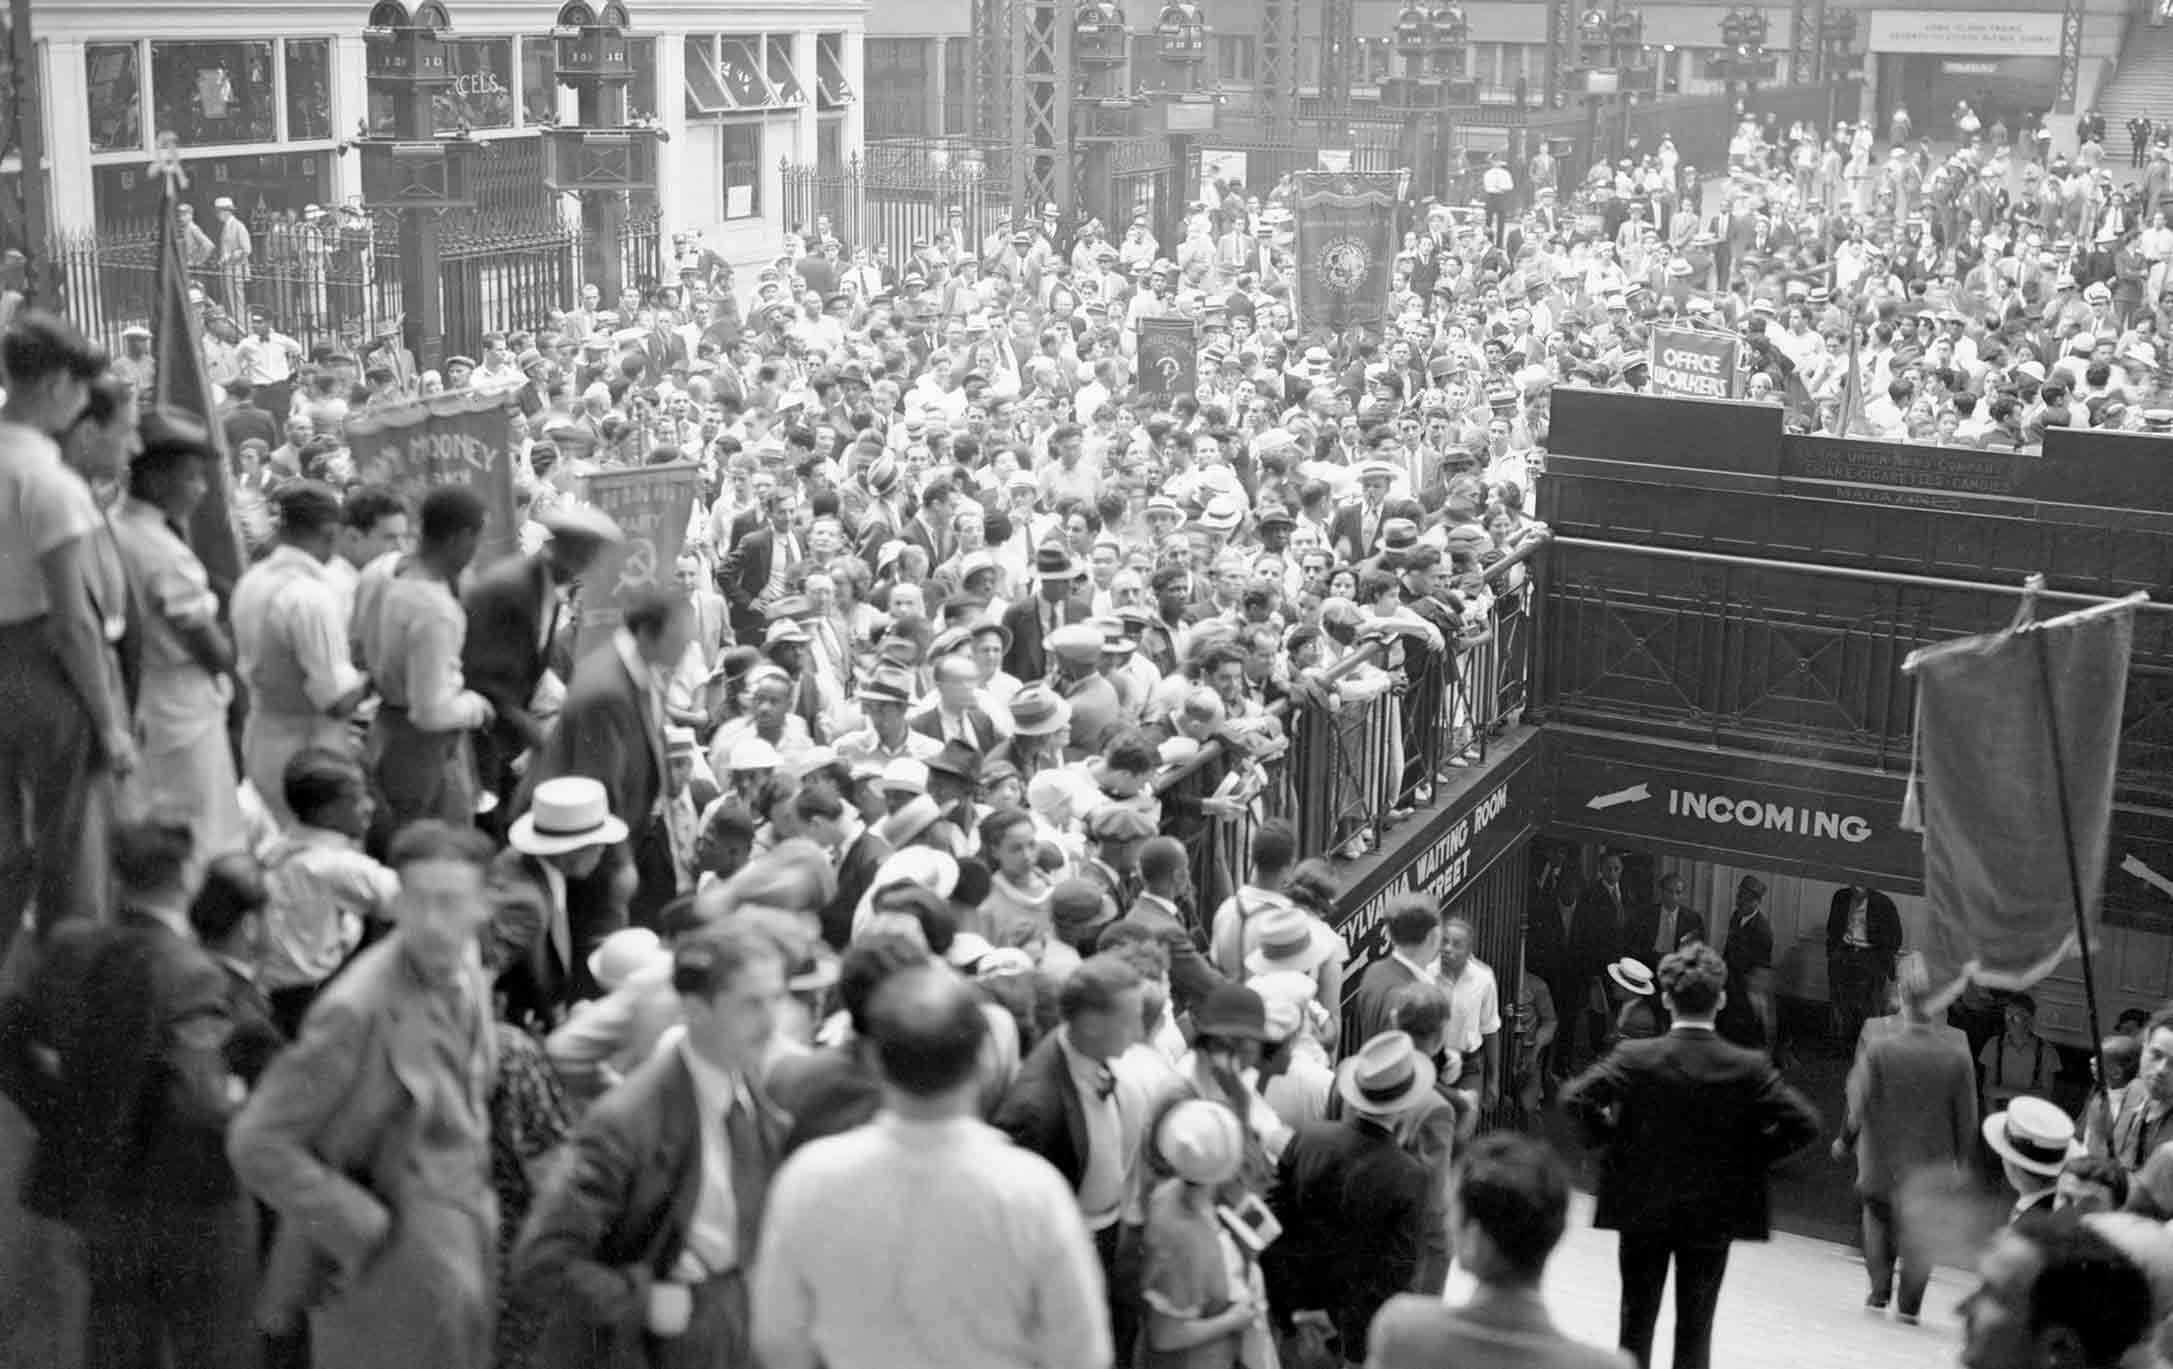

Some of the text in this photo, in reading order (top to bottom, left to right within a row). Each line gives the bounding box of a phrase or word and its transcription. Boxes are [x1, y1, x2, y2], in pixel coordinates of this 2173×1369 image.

[1654, 366, 1728, 397] WORKERS
[1663, 348, 1721, 374] OFFICE
[410, 432, 498, 473] MOONEY
[1416, 820, 1469, 885] WAITING
[1474, 784, 1507, 834] ROOM
[1669, 789, 1872, 842] INCOMING
[1423, 849, 1471, 899] TREET
